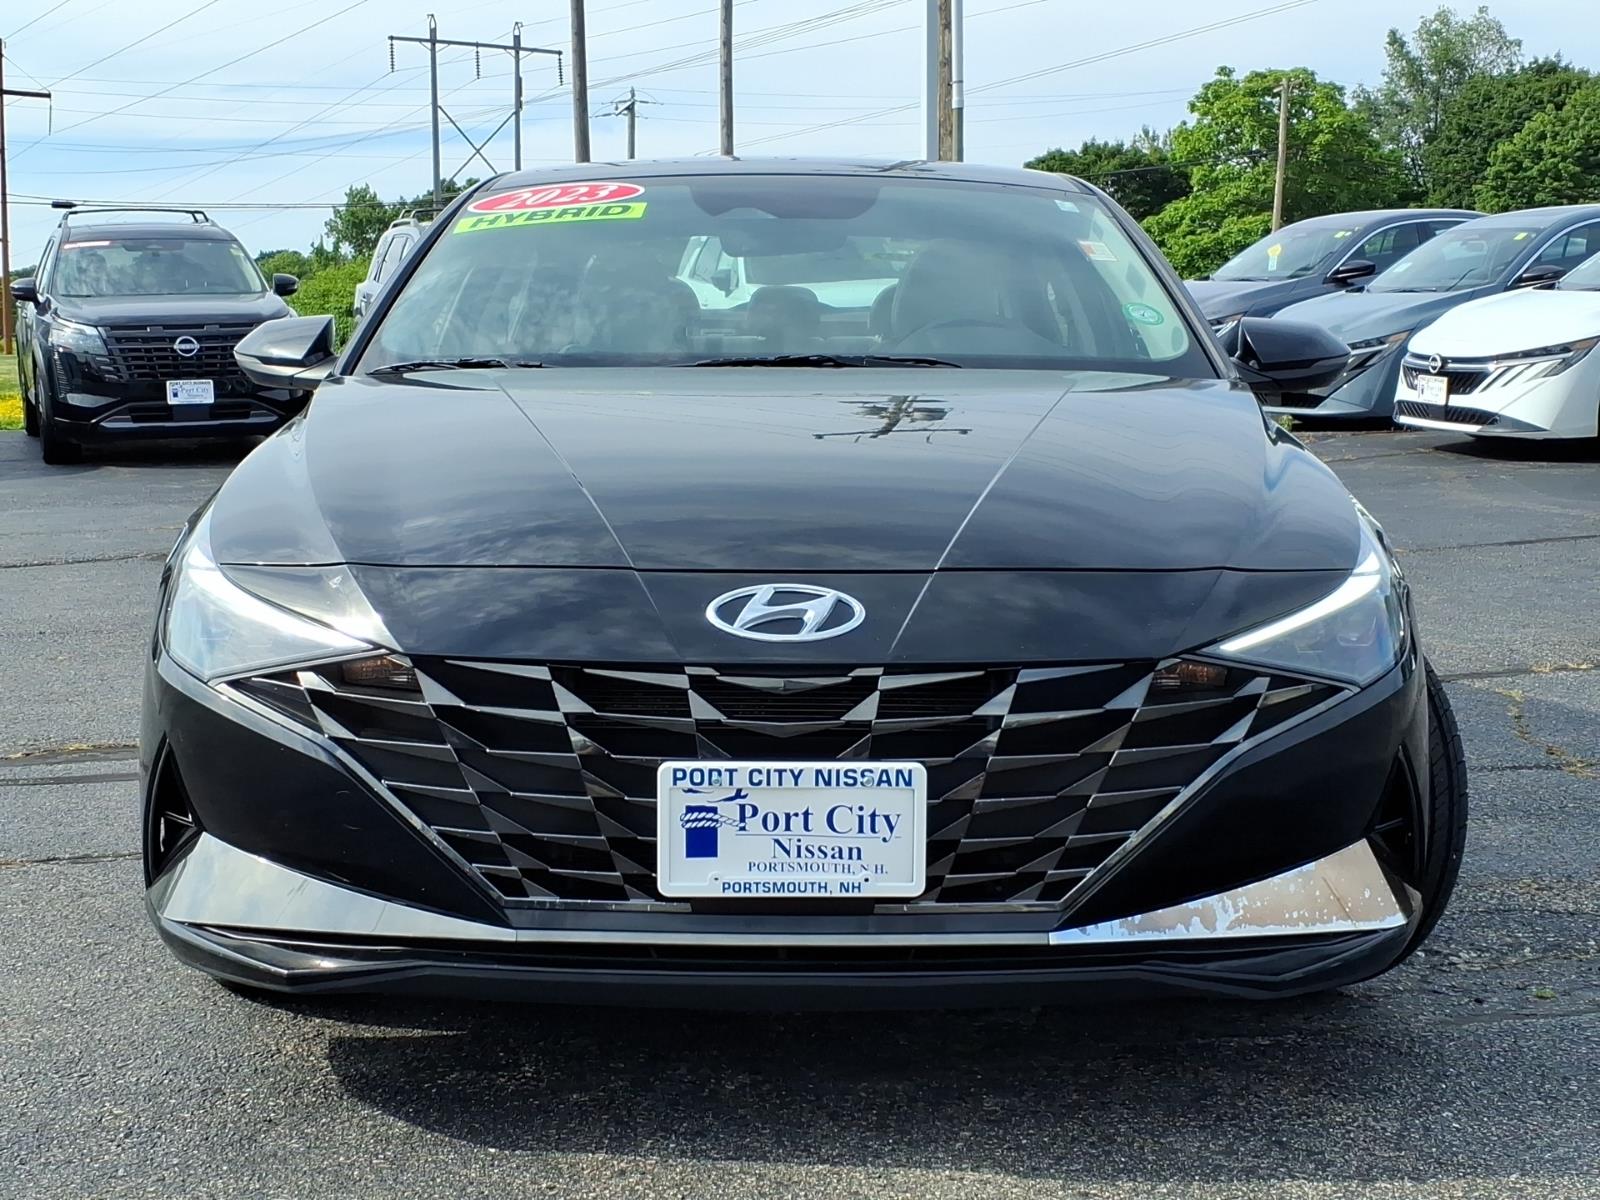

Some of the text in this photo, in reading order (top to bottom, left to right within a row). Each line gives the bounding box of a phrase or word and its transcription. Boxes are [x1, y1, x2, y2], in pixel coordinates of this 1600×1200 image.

[496, 184, 620, 210] 2023
[468, 204, 632, 229] HYBRID
[671, 767, 913, 788] PORT CITY NISSAN
[736, 802, 902, 843] Port City
[771, 837, 863, 861] Nissan
[748, 861, 856, 876] PORTSMOUTH,
[721, 880, 862, 896] PORTSMOUTH, NH
